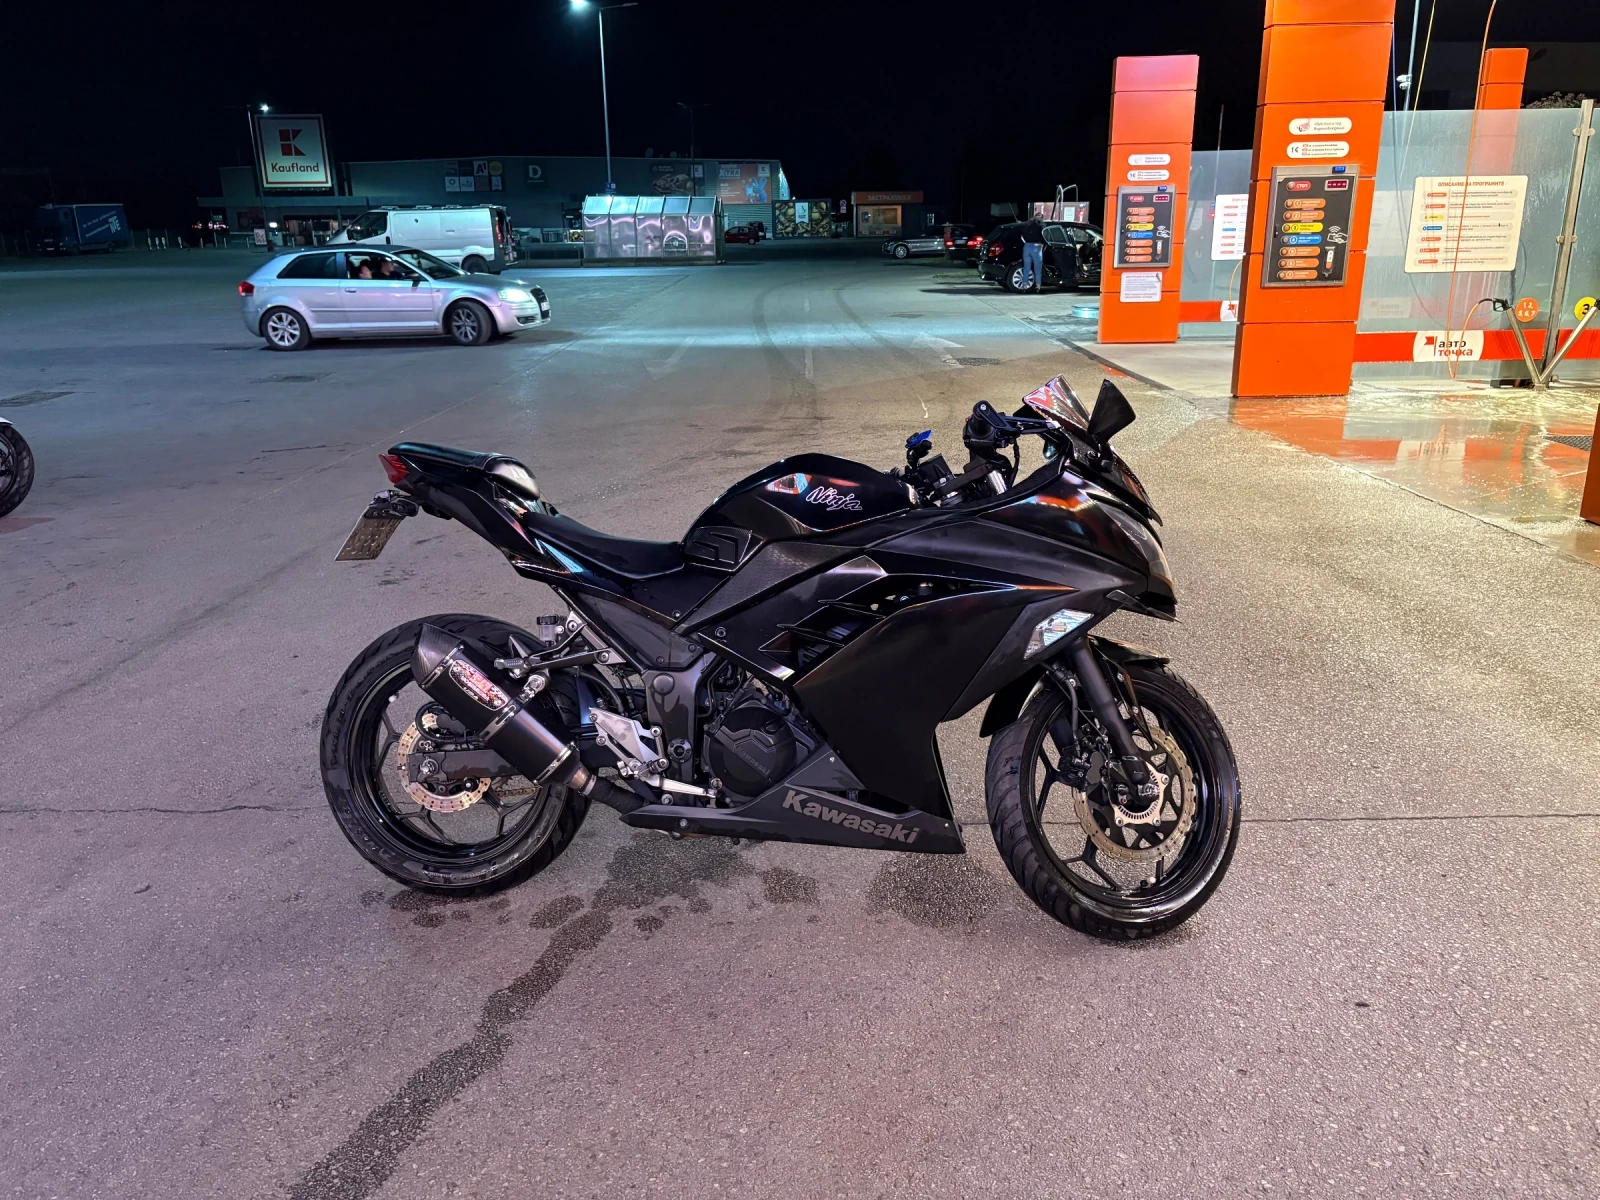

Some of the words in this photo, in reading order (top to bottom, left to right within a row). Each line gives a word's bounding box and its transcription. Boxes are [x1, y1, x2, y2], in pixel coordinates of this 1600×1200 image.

[271, 162, 320, 173] Kaufland
[528, 164, 542, 179] D
[1438, 340, 1467, 348] авто
[1438, 348, 1473, 357] точка
[805, 486, 863, 511] Ninja
[736, 745, 771, 775] Kawasaki
[782, 789, 921, 844] Kawasaki
